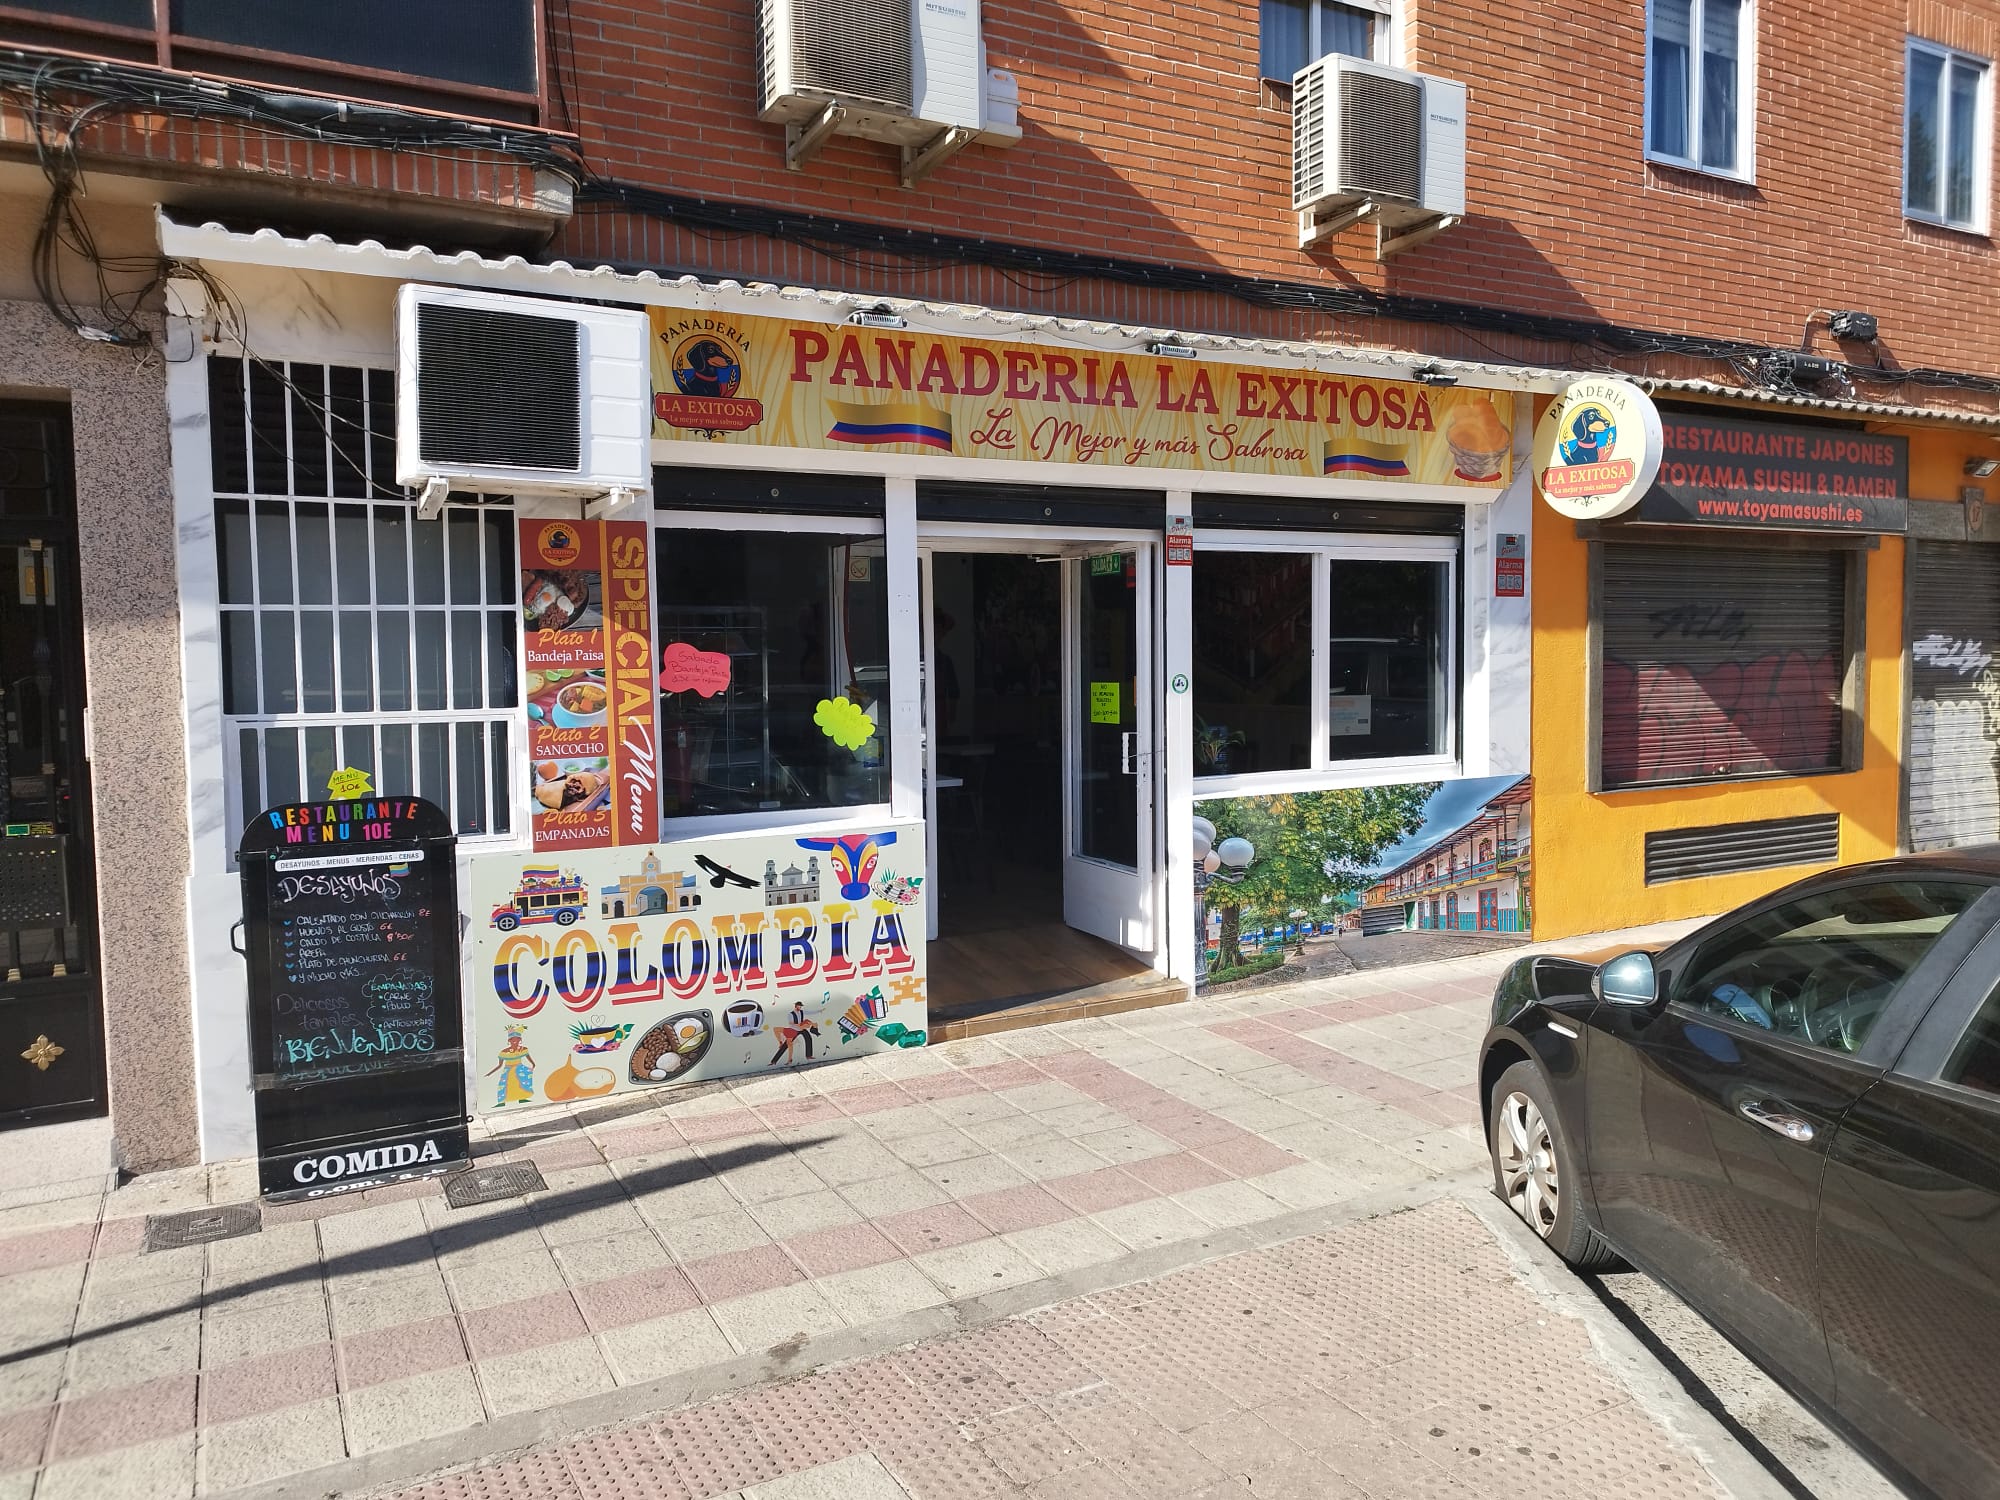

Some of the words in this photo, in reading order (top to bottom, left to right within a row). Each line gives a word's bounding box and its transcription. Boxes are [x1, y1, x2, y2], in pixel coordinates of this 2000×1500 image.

[660, 318, 750, 353] PANADERÍA
[789, 329, 1138, 409] PANADERIA
[1155, 363, 1220, 415] LA
[1236, 371, 1437, 433] EXITOSA
[662, 399, 682, 413] LA
[687, 400, 756, 418] EXITOSA
[1549, 385, 1627, 420] PANADERÍA
[970, 407, 1016, 450] La
[1029, 415, 1127, 463] Mejor
[1124, 437, 1151, 466] y
[1154, 430, 1201, 456] más
[1196, 423, 1309, 462] Sabrosa
[1662, 424, 1806, 461] RESTAURANTE
[1810, 439, 1895, 467] JAPONES
[1548, 472, 1566, 486] LA
[1569, 465, 1628, 484] EXITOSA
[1659, 462, 1748, 492] TOYAMA
[1753, 468, 1812, 494] SUSHI
[1816, 474, 1829, 495] &
[1833, 474, 1897, 499] RAMEN
[1697, 499, 1864, 523] www.toyamasushi.es
[1169, 536, 1191, 544] Alarma
[1498, 560, 1523, 569] Alarma
[538, 628, 585, 647] Plato
[590, 628, 598, 644] 1
[611, 535, 652, 746] SPECIAL
[528, 650, 572, 665] Bandeja
[575, 650, 604, 661] Paisa
[538, 726, 584, 744] Plato
[589, 726, 601, 740] 2
[536, 743, 604, 756] SANCOCHO
[623, 715, 656, 837] Menu
[268, 801, 419, 830] RESTAURANTE
[543, 808, 589, 828] Plato
[593, 806, 606, 823] 3
[286, 822, 350, 844] MENU
[362, 822, 393, 841] 10E
[535, 826, 610, 842] EMPANADAS
[280, 860, 321, 869] DESAYUNOS
[326, 858, 350, 866] MENUS
[356, 855, 393, 863] MERIENDAS
[398, 853, 420, 861] CENAS
[278, 868, 401, 903] DESAYUNOS
[350, 912, 368, 921] CON
[298, 926, 333, 937] HUEVOS
[299, 938, 328, 948] CALDO
[331, 935, 342, 944] DE
[346, 933, 382, 943] COSTILLA
[298, 958, 323, 969] PLATO
[326, 957, 338, 967] DE
[493, 899, 916, 1019] COLOMBIA
[308, 973, 337, 983] MUCHO
[285, 1028, 435, 1063] BIENVENIDOS
[293, 1139, 443, 1183] COMIDA
